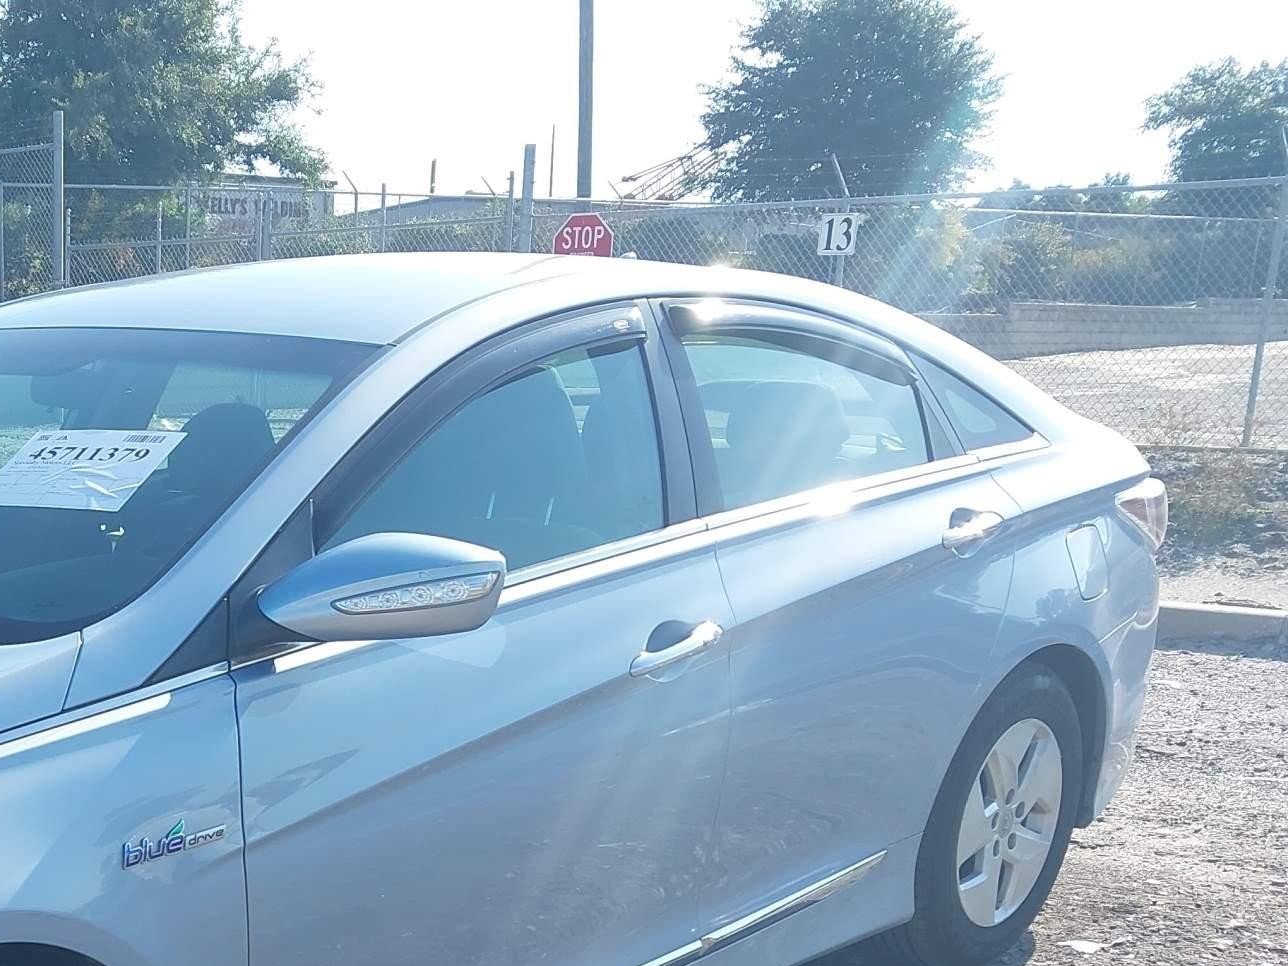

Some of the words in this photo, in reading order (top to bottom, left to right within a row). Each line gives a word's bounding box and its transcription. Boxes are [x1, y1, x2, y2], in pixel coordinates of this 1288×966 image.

[562, 226, 605, 249] STOP
[822, 217, 853, 251] 13
[29, 446, 150, 462] 45711379
[123, 833, 184, 869] blue
[187, 828, 225, 846] drive
